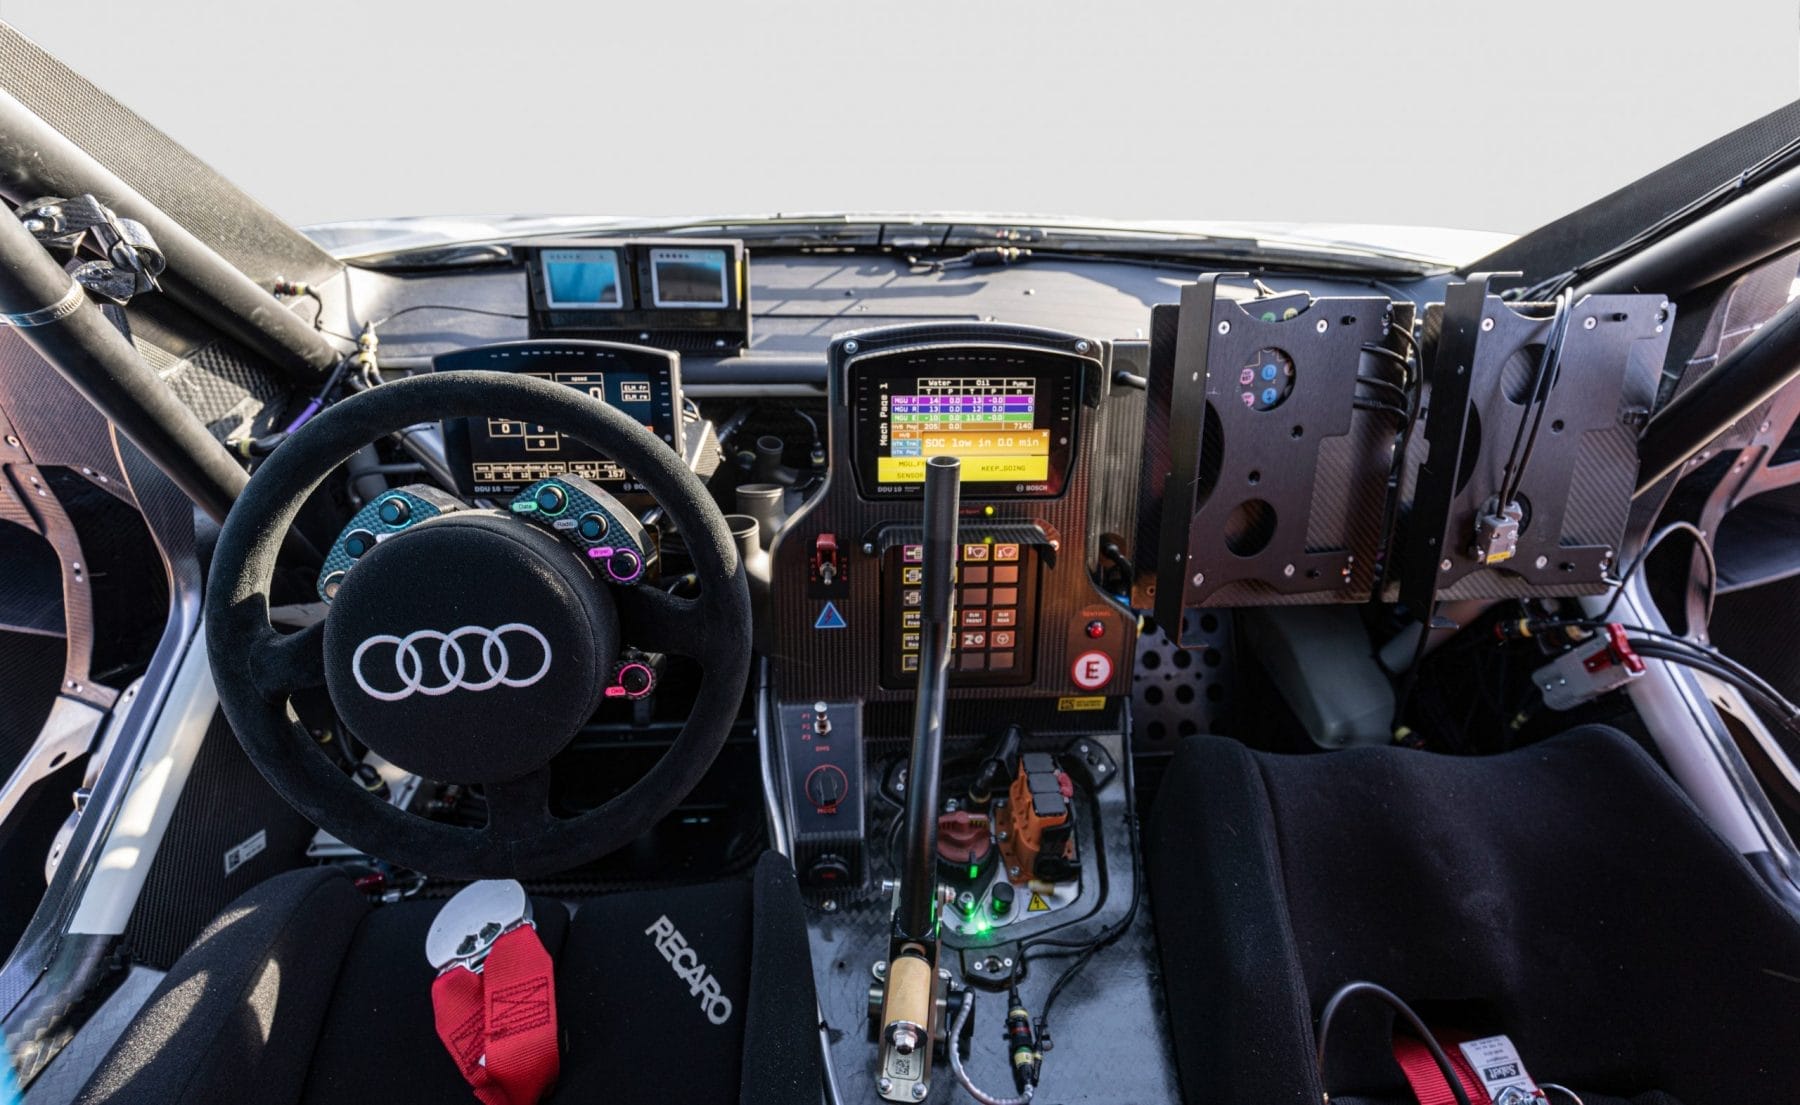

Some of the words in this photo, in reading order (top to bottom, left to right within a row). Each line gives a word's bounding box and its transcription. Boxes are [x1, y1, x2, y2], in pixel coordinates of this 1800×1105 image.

[880, 394, 888, 418] Page
[880, 422, 888, 446] Mech
[925, 439, 945, 447] SOC
[952, 438, 972, 447] low
[978, 438, 991, 447] in
[1019, 438, 1039, 447] min
[1085, 661, 1099, 679] E
[645, 914, 732, 1025] RECARO
